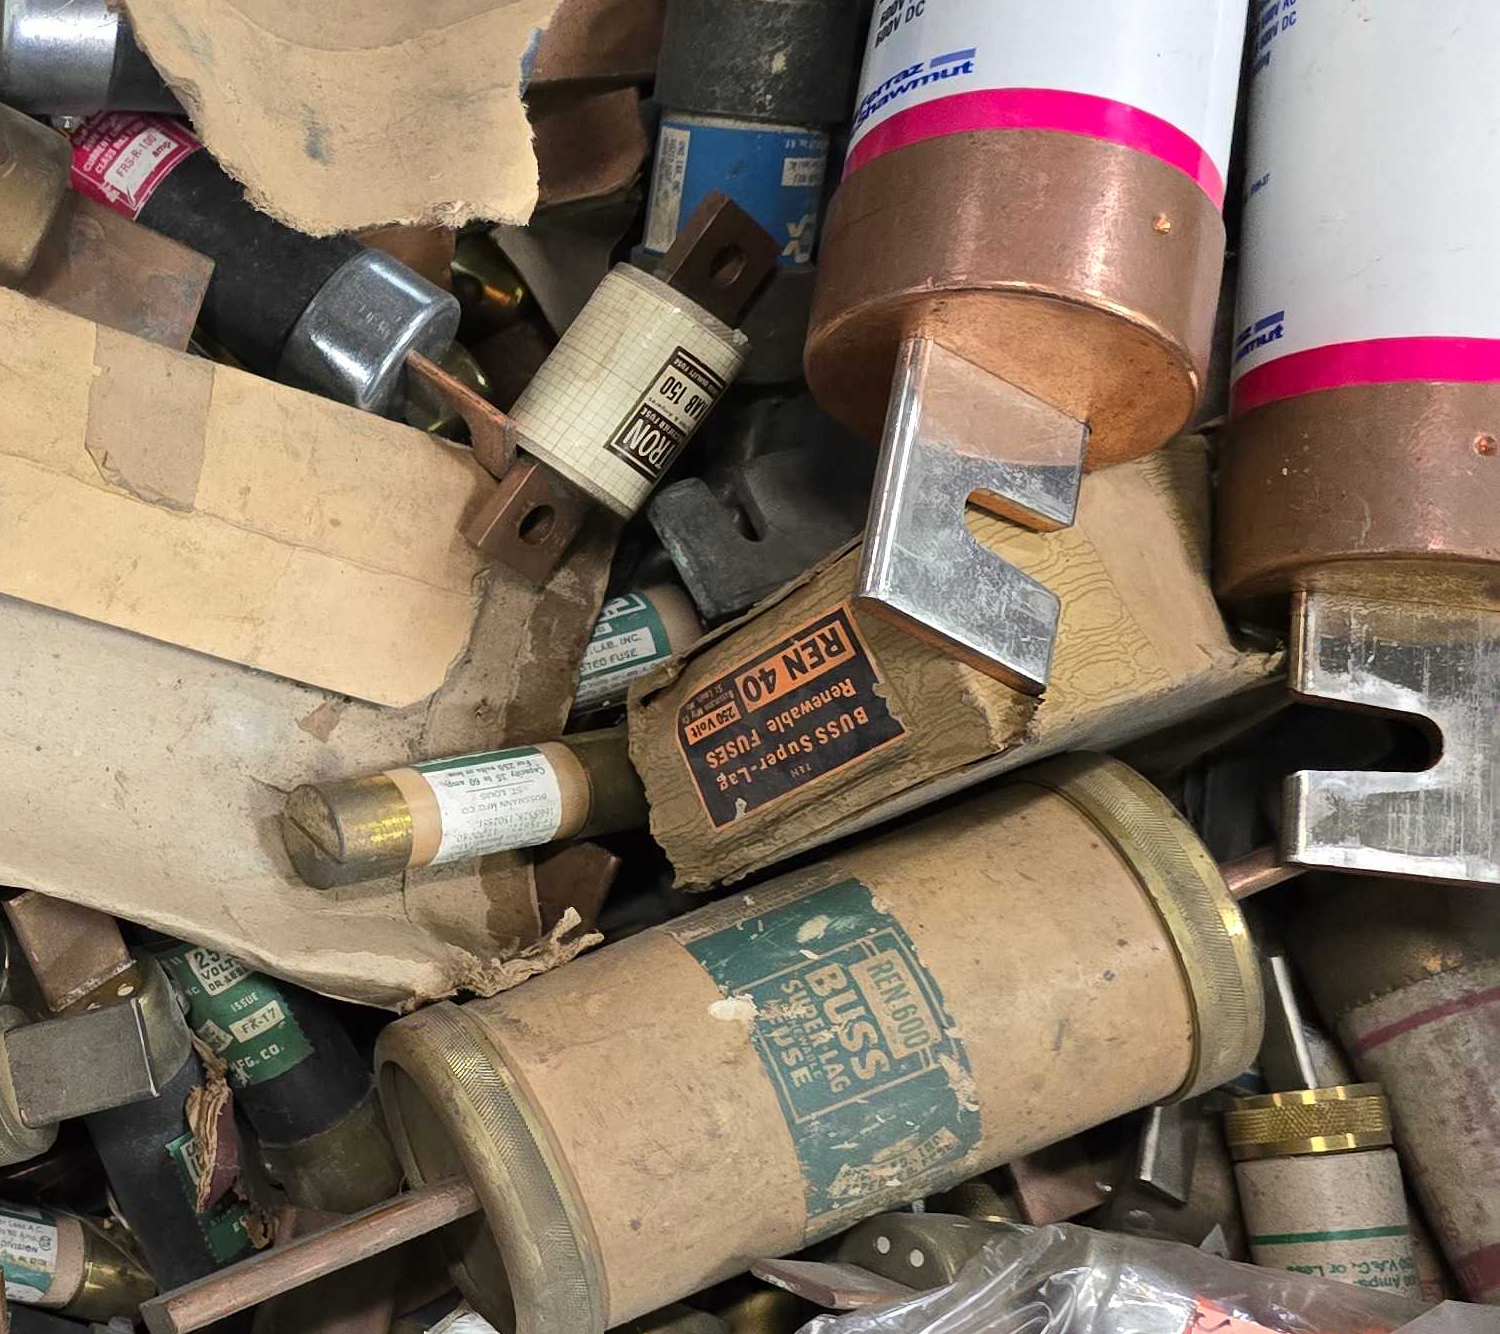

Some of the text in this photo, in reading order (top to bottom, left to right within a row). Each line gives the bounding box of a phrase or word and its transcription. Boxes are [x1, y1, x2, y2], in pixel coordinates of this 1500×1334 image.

[904, 0, 926, 23] DC
[1280, 9, 1298, 33] DC
[656, 373, 689, 406] 150
[620, 415, 677, 470] TRON
[736, 624, 848, 705] REN 40
[687, 705, 737, 740] 250 Volt
[702, 677, 857, 770] Renewable FUSES
[712, 704, 870, 796] BUSS Super-Lag
[200, 956, 239, 981] VOLT
[229, 991, 260, 1013] ISSUE
[803, 957, 892, 1087] BUSS
[865, 957, 931, 1052] REN 600
